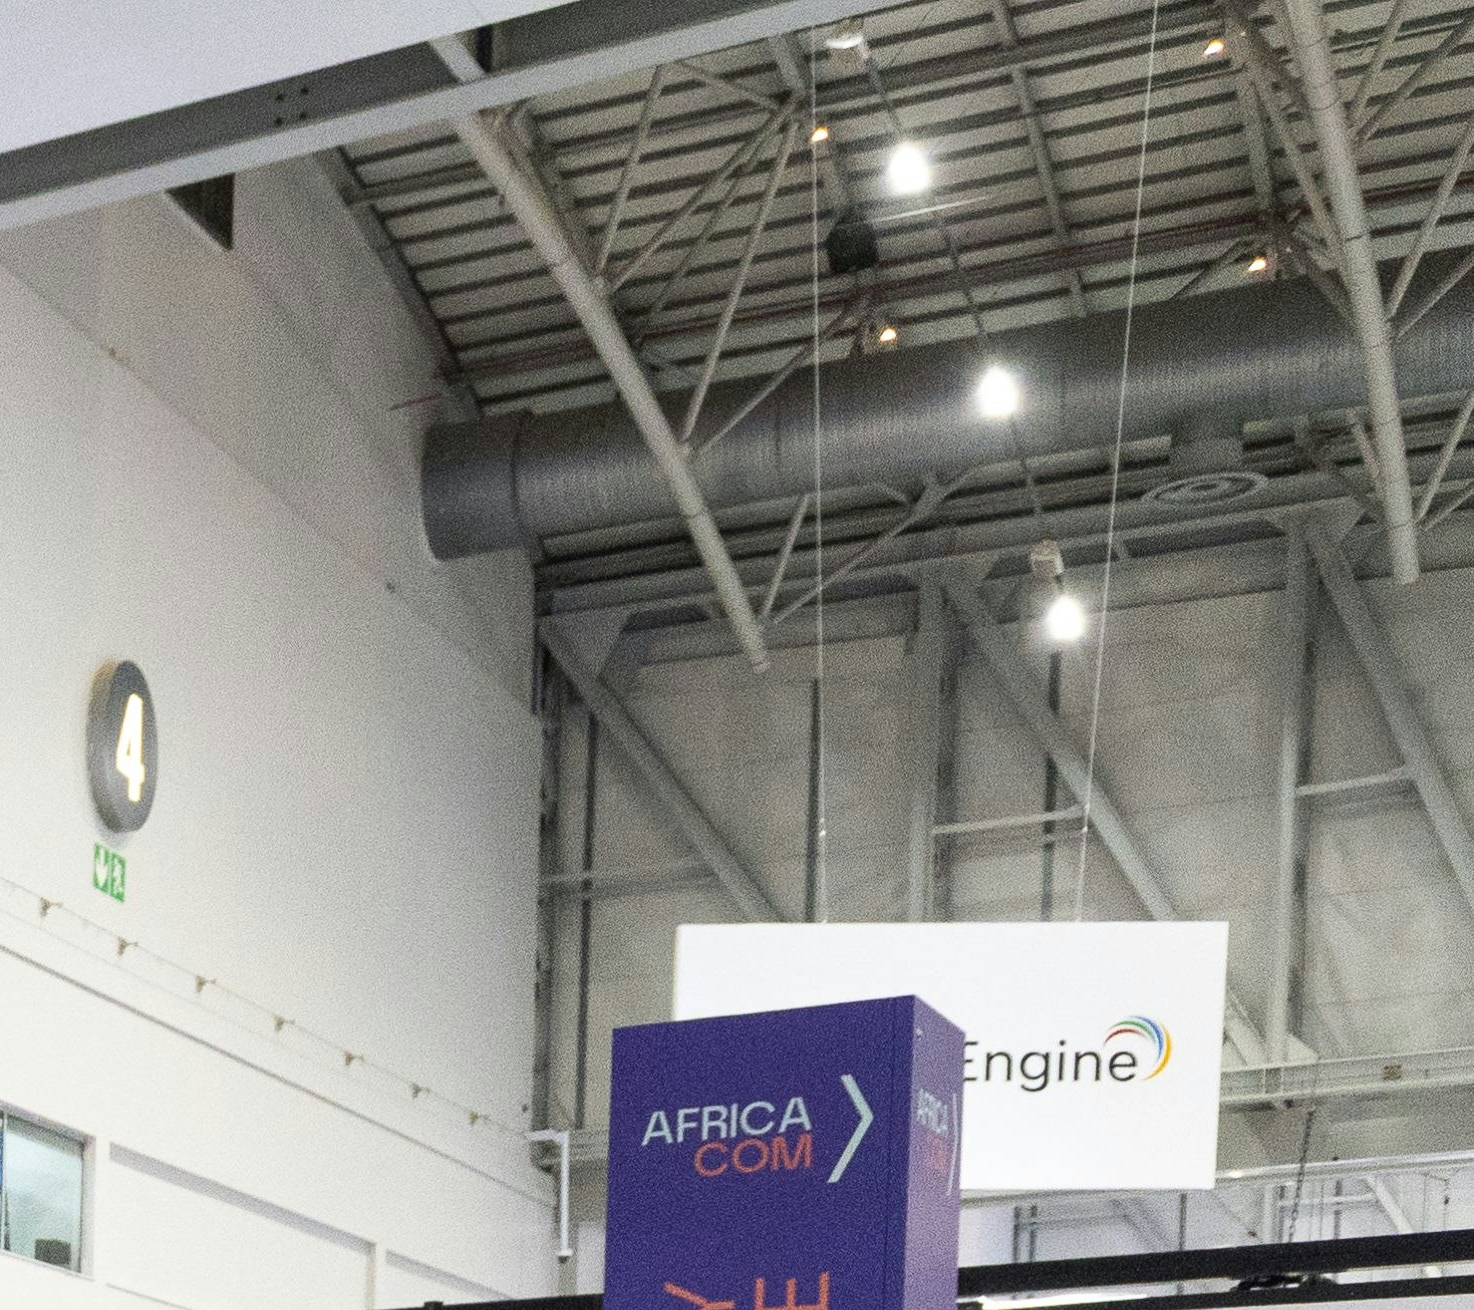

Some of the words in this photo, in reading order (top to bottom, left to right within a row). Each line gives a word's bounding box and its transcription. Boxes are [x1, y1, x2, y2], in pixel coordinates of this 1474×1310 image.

[116, 693, 145, 802] 4
[642, 1096, 813, 1146] AFRICA
[694, 1133, 813, 1177] COM
